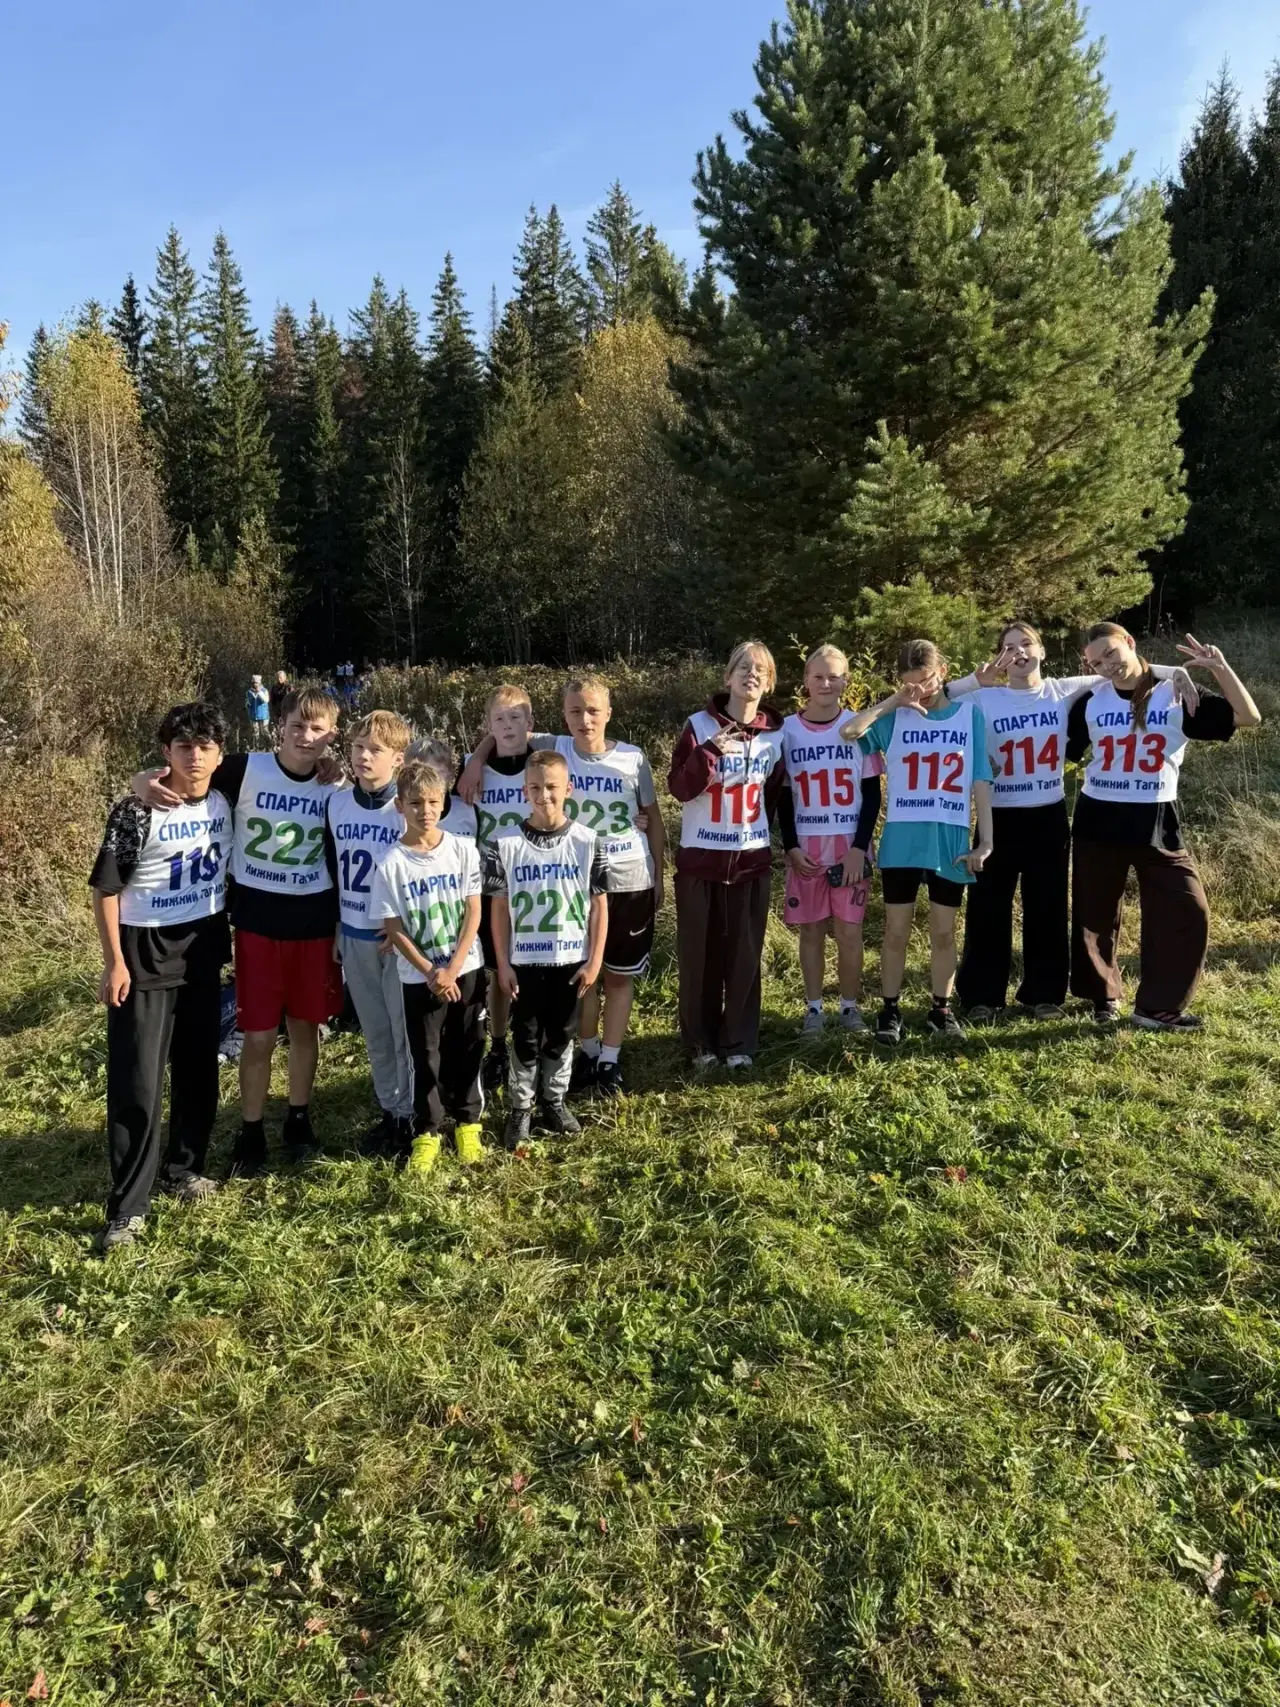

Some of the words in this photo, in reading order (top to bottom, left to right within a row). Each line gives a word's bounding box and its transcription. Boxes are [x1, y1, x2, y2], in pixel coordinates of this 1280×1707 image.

[993, 711, 1059, 734] СПАРТАК
[1096, 710, 1169, 727] СПАРАК
[902, 730, 968, 747] СПАРТАК
[791, 745, 853, 763] СПАРТАК
[999, 734, 1060, 776] 114
[1098, 733, 1167, 773] 113
[902, 751, 964, 794] 112
[570, 774, 623, 793] ПАРТАК
[794, 767, 854, 808] 115
[994, 780, 1033, 793] Нижний
[1090, 776, 1130, 790] Нижний
[1134, 779, 1165, 791] Тагил
[706, 782, 761, 824] 119
[896, 797, 935, 808] Нижний
[939, 797, 964, 811] Тагил
[158, 817, 225, 841] СПАРТАК
[697, 828, 739, 842] Нижний
[743, 829, 768, 842] Тагил
[245, 862, 287, 883] Нижний
[340, 849, 377, 893] 12
[152, 892, 199, 908] Нижний
[851, 886, 867, 906] 10
